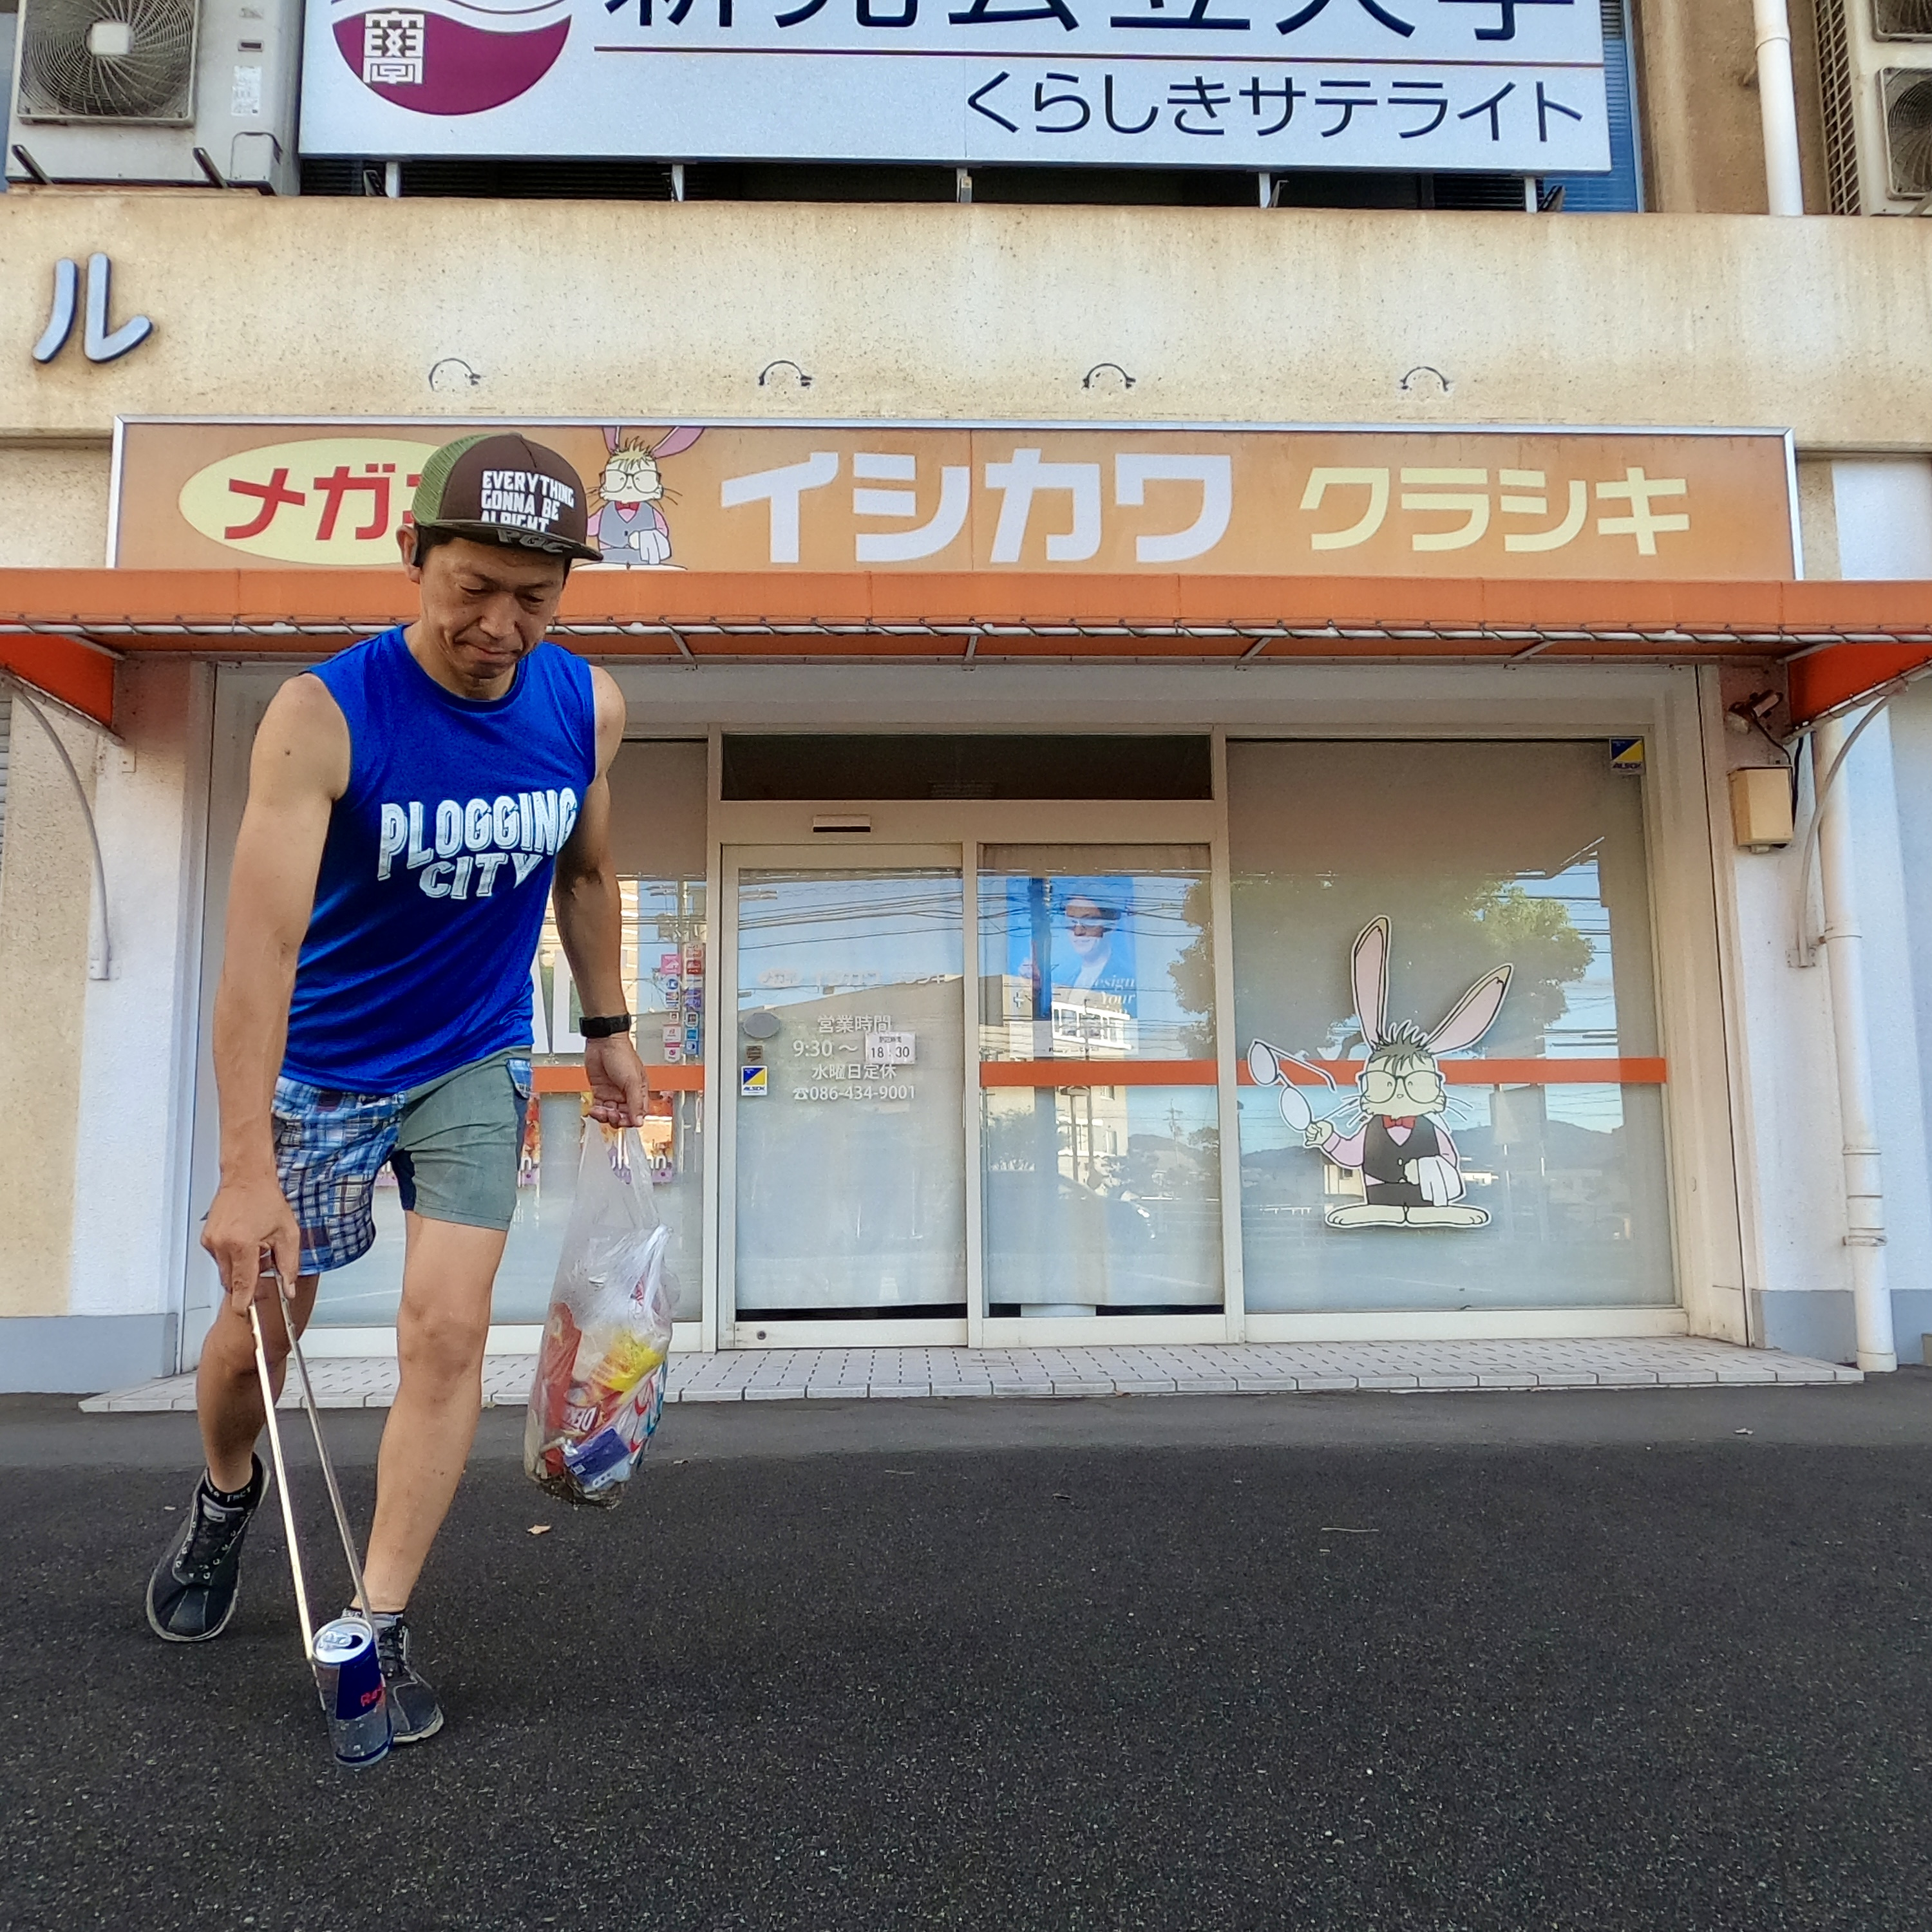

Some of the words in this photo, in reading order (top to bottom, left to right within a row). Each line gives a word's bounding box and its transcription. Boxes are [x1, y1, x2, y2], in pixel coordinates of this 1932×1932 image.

[967, 70, 1583, 142] くらしきサテライト
[32, 252, 153, 364] ル
[224, 462, 422, 541] メガ
[480, 489, 535, 516] GONNA
[542, 497, 561, 522] BE
[481, 470, 575, 509] EVERYTHING
[720, 448, 1233, 564] イシカワ
[1299, 466, 1690, 556] クラシキ
[377, 786, 578, 882] PLOGGING
[419, 852, 543, 900] CITY
[817, 1014, 891, 1034] 営業時間
[811, 1064, 897, 1081] 水曜日定休
